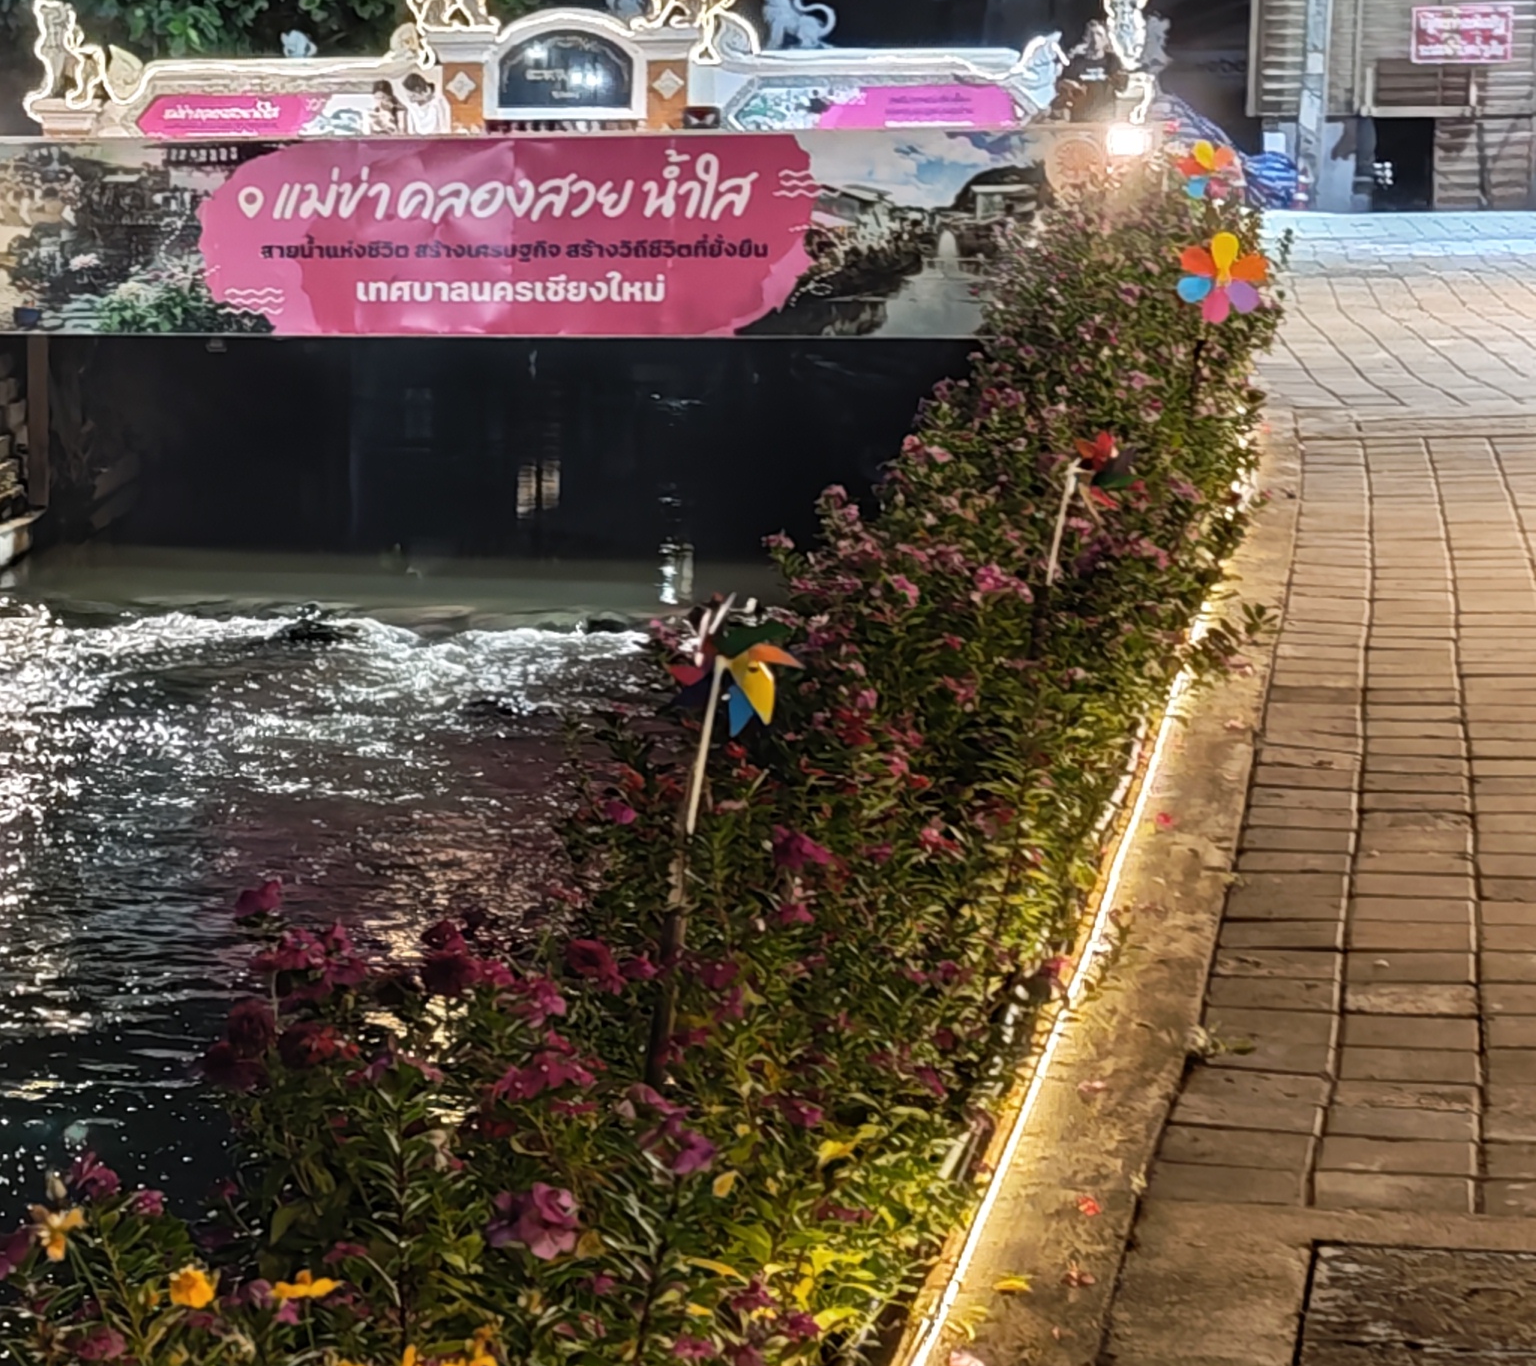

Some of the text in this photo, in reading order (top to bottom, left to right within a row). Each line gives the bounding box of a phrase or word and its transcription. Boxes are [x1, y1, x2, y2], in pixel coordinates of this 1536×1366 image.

[272, 149, 760, 224] แม่ข่า คลองสวย น้ำใส
[260, 233, 410, 259] สายน้ำแห่งชีวิต
[356, 270, 666, 304] เทศบาลนครเชียงใหม่
